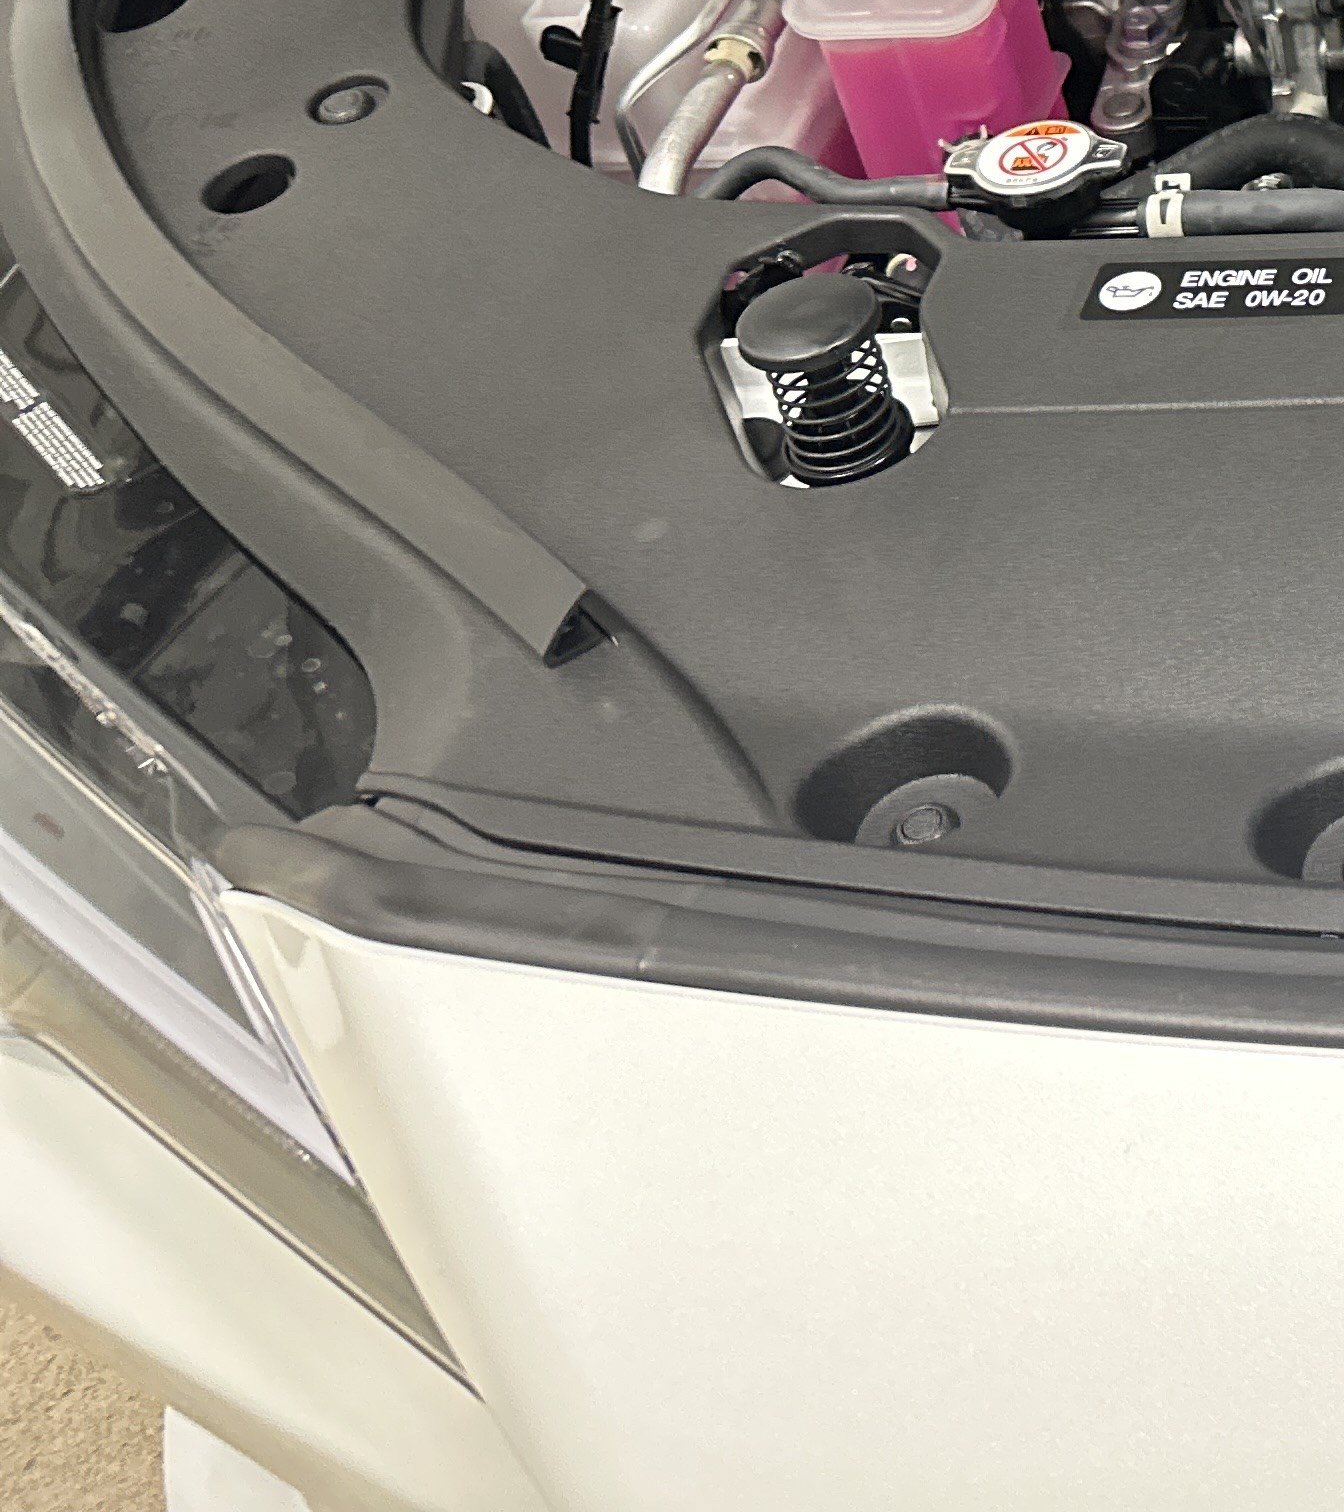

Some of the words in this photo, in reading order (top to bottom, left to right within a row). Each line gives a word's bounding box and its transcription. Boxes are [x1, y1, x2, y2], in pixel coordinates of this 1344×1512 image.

[1180, 269, 1277, 287] ENGINE
[1291, 268, 1333, 284] OIL
[1172, 291, 1229, 309] SAE
[1244, 289, 1326, 307] 0W-20
